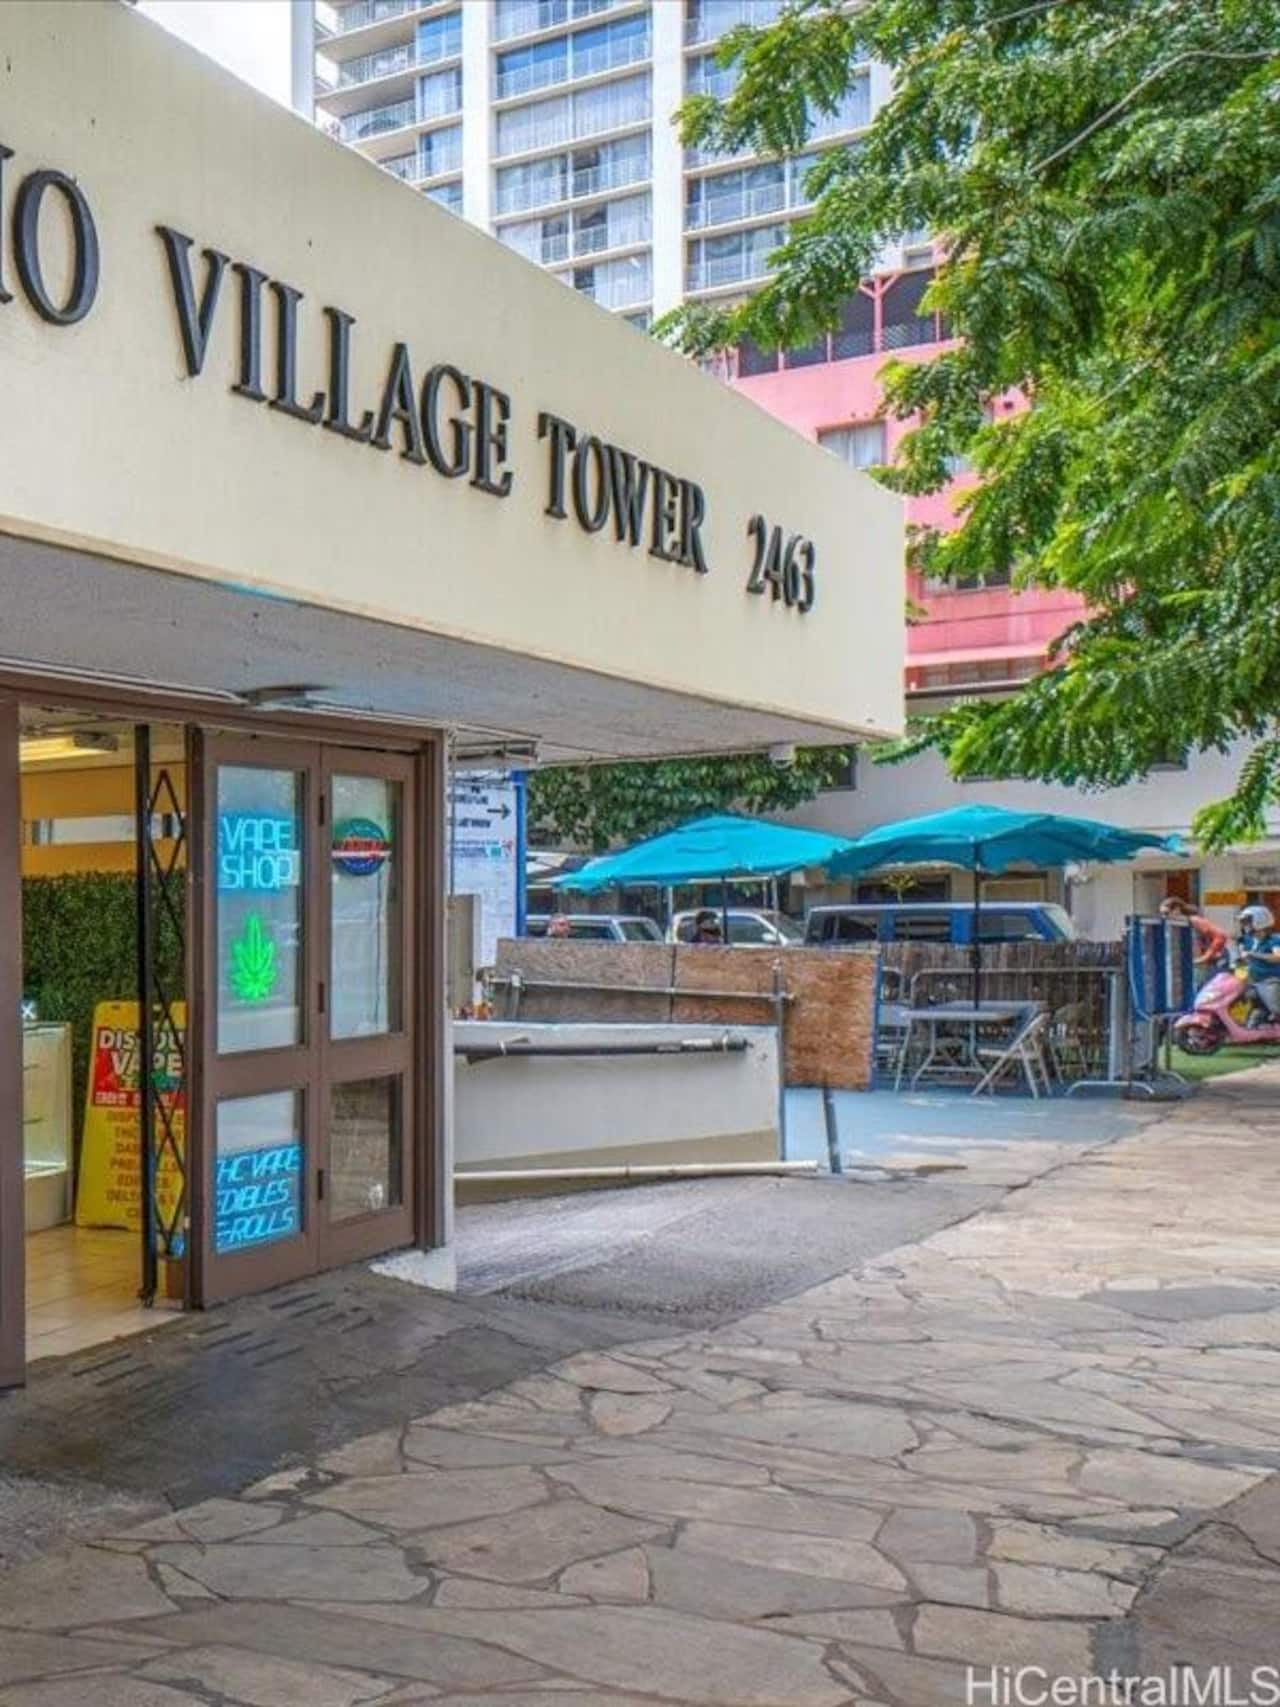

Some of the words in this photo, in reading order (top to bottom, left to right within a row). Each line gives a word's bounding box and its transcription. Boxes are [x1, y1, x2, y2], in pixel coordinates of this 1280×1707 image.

[154, 224, 514, 498] VILLAGE
[537, 411, 709, 574] TOWER
[745, 512, 816, 615] 2463
[222, 815, 292, 853] VAPE
[218, 854, 293, 890] SHOP
